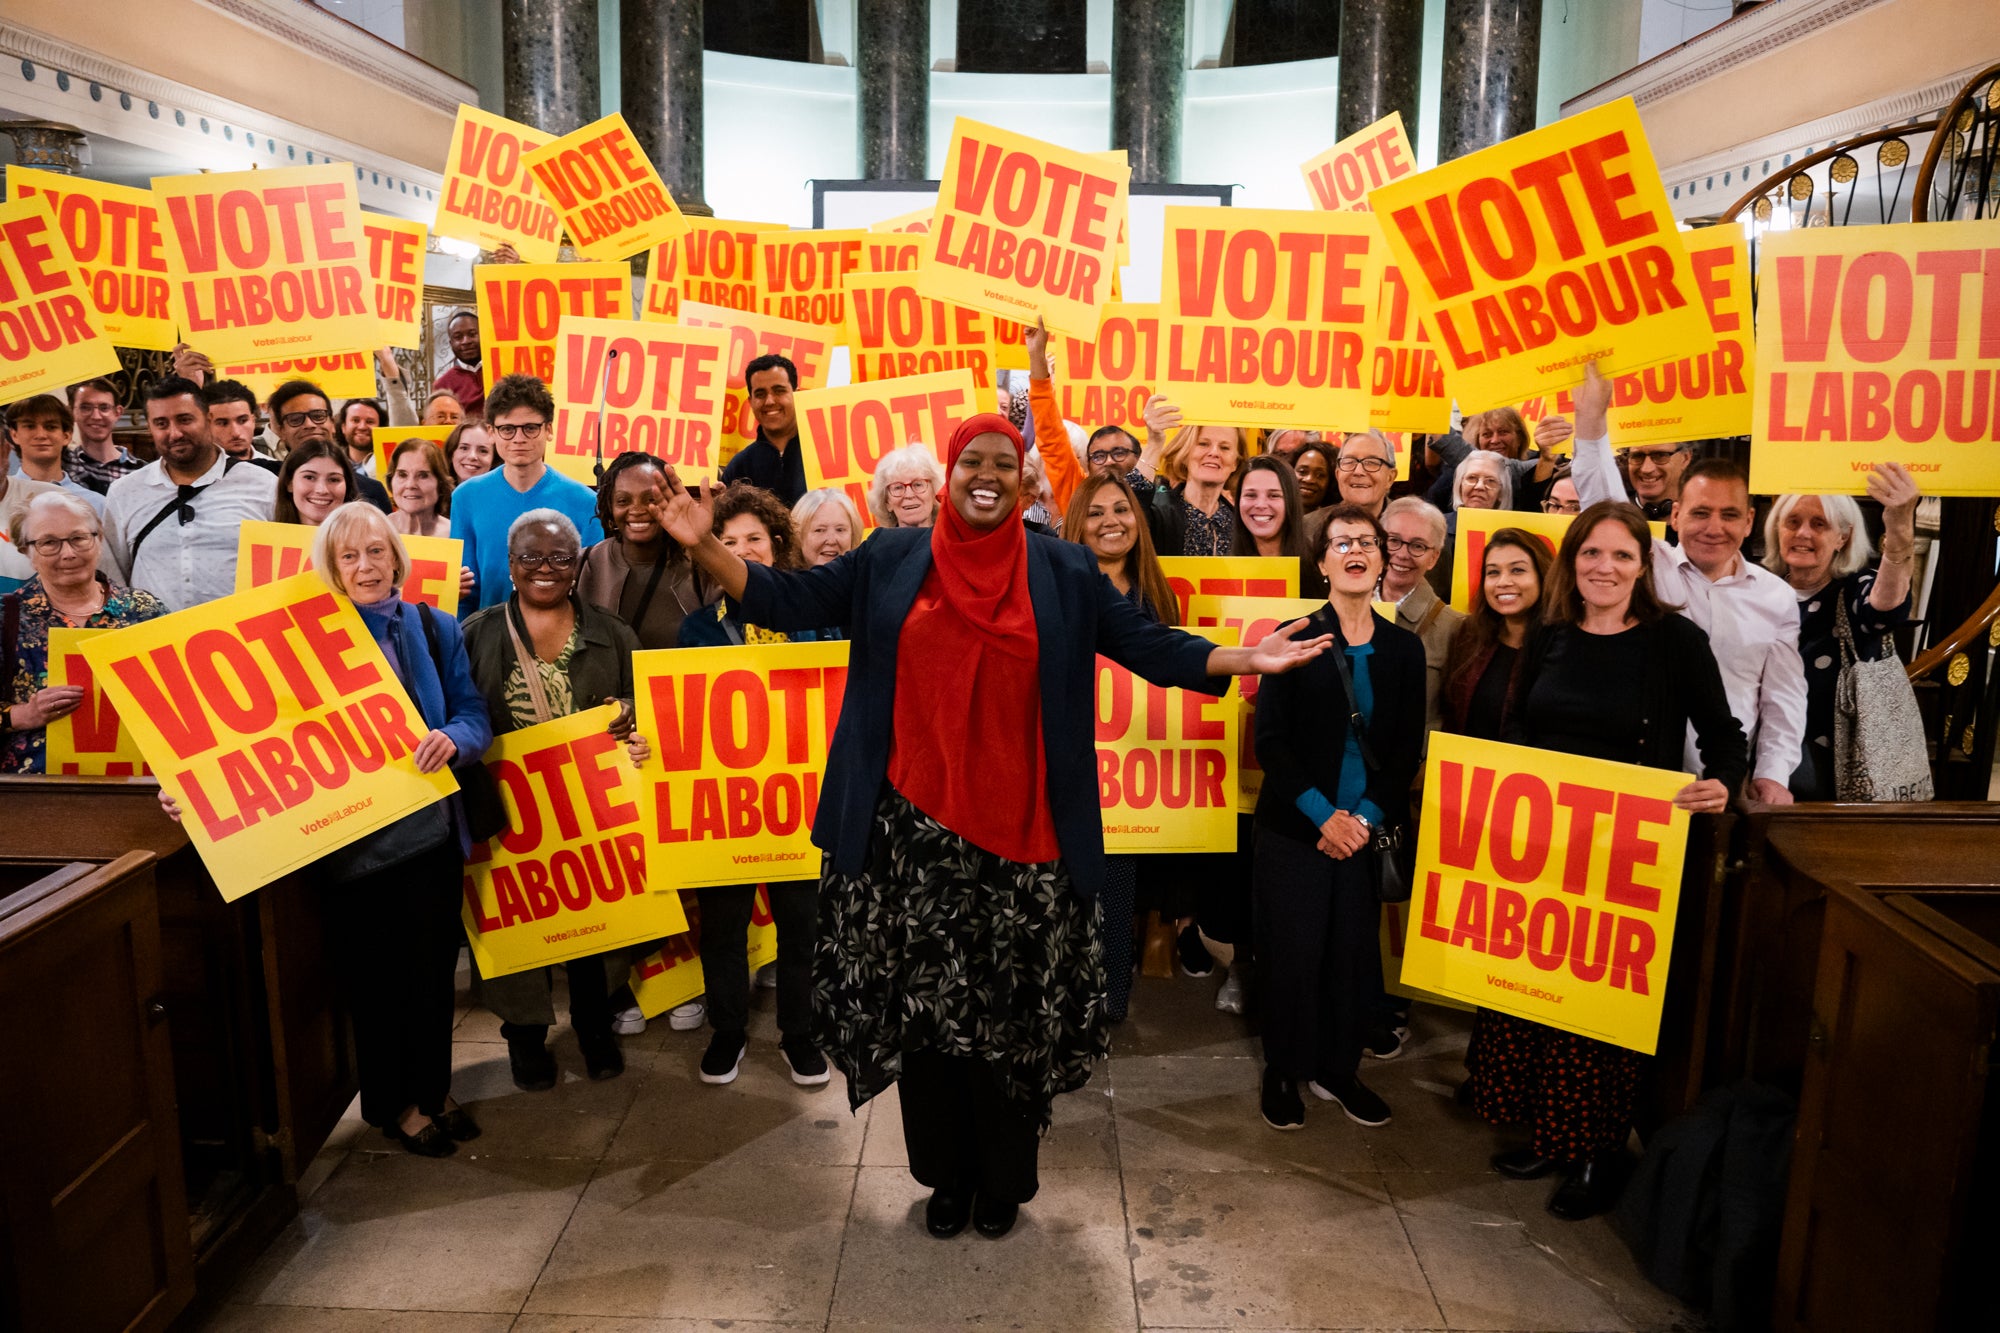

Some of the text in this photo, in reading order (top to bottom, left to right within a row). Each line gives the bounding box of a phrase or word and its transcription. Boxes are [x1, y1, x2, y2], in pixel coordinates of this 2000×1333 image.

[445, 177, 558, 243] LABOUR
[532, 128, 649, 210] VOTE
[954, 137, 1117, 252] VOTE
[1308, 127, 1411, 212] VOTE
[18, 185, 168, 273] OTE
[166, 182, 356, 273] VOTE
[565, 183, 672, 247] LABOUR
[684, 229, 757, 281] VOT
[1391, 130, 1659, 301] VOTE
[183, 266, 368, 333] LABOUR
[935, 215, 1101, 306] LABOUR
[1175, 228, 1370, 324] VOTE
[1434, 245, 1688, 371] LABOUR
[567, 333, 719, 415] VOTE
[1168, 324, 1364, 390] LABOUR
[555, 409, 712, 468] LABOUR
[1062, 385, 1152, 427] LABO
[1768, 368, 2000, 443] LABOU
[1903, 463, 1942, 472] abour
[110, 592, 384, 760] VOTE
[175, 692, 421, 843] LABOUR
[465, 731, 641, 866] OTE
[655, 773, 818, 844] LABO
[1096, 748, 1227, 810] BOUR
[300, 817, 330, 836] Vote
[732, 854, 760, 864] Vote
[1101, 824, 1118, 834] ote
[1439, 760, 1673, 912] VOTE
[1419, 871, 1657, 996] LABOUR
